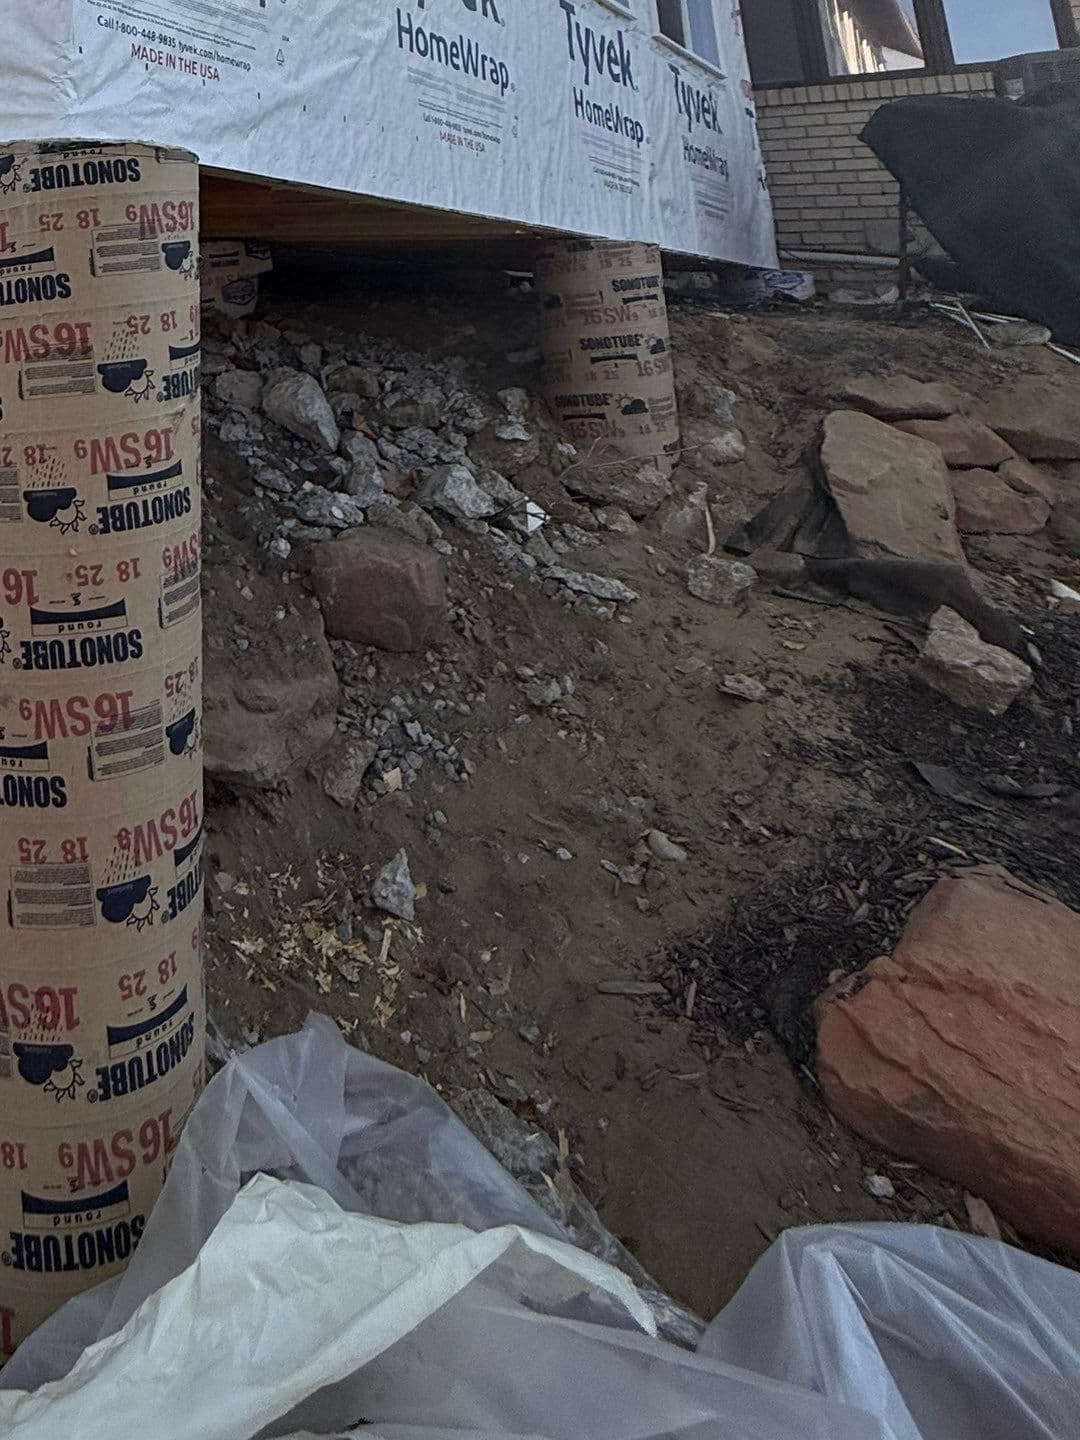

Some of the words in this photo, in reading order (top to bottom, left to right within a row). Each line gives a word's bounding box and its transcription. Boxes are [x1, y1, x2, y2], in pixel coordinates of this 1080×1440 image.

[97, 14, 115, 30] Call
[114, 20, 177, 48] 1-800-448-9835
[178, 41, 252, 72] tyvek.com/homewrap
[397, 7, 509, 97] HomeWrap
[131, 43, 164, 66] MADE
[165, 53, 177, 68] IN
[178, 57, 198, 76] THE
[200, 63, 220, 82] USA
[670, 65, 723, 136] Tyvek
[573, 86, 644, 148] HomeWrap
[30, 158, 141, 192] SONOTUBE
[39, 212, 64, 233] 25
[76, 208, 101, 230] 18
[126, 315, 151, 336] 25
[160, 311, 178, 333] 18
[579, 334, 641, 351] SONOTUBE
[23, 443, 49, 467] 18
[97, 486, 192, 535] SONOTUBE
[75, 563, 105, 588] 25
[116, 557, 141, 584] 18
[58, 621, 102, 634] round
[20, 629, 143, 671] SONOTUBE
[164, 671, 185, 698] 25
[18, 837, 46, 864] 25
[61, 837, 88, 862] 18
[159, 950, 178, 986] 18
[120, 968, 146, 1001] 25
[136, 1019, 174, 1046] round
[97, 1013, 196, 1102] SONOTUBE
[1, 1141, 28, 1170] 18
[53, 1210, 102, 1227] round
[10, 1215, 146, 1273] SONOTUBE
